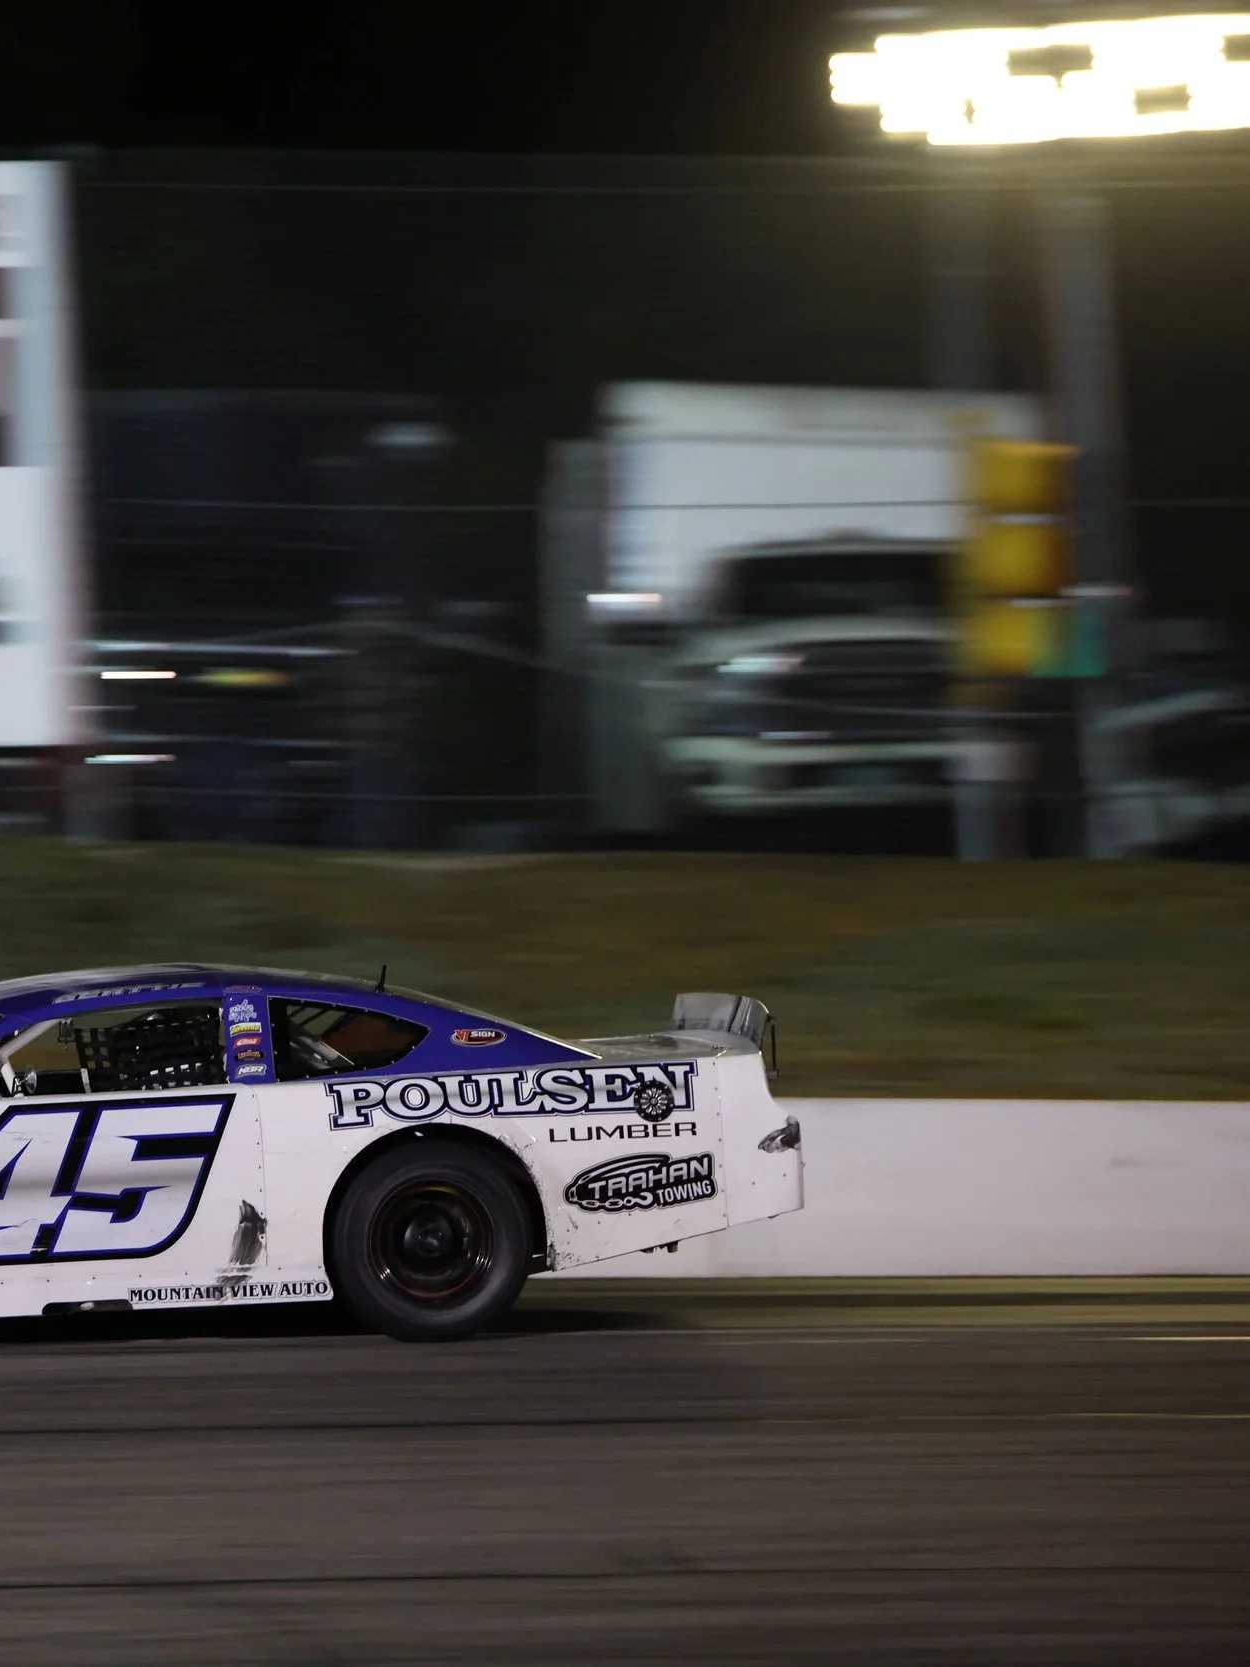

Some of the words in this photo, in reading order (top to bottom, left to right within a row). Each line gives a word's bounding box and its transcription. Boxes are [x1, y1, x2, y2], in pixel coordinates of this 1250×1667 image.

[326, 1060, 697, 1131] POULSEN
[549, 1122, 697, 1142] LUMBER
[656, 1180, 711, 1203] TOWING
[130, 1286, 223, 1301] MOUNTAIN
[230, 1284, 274, 1297] VIEW
[280, 1282, 329, 1296] AUTO
